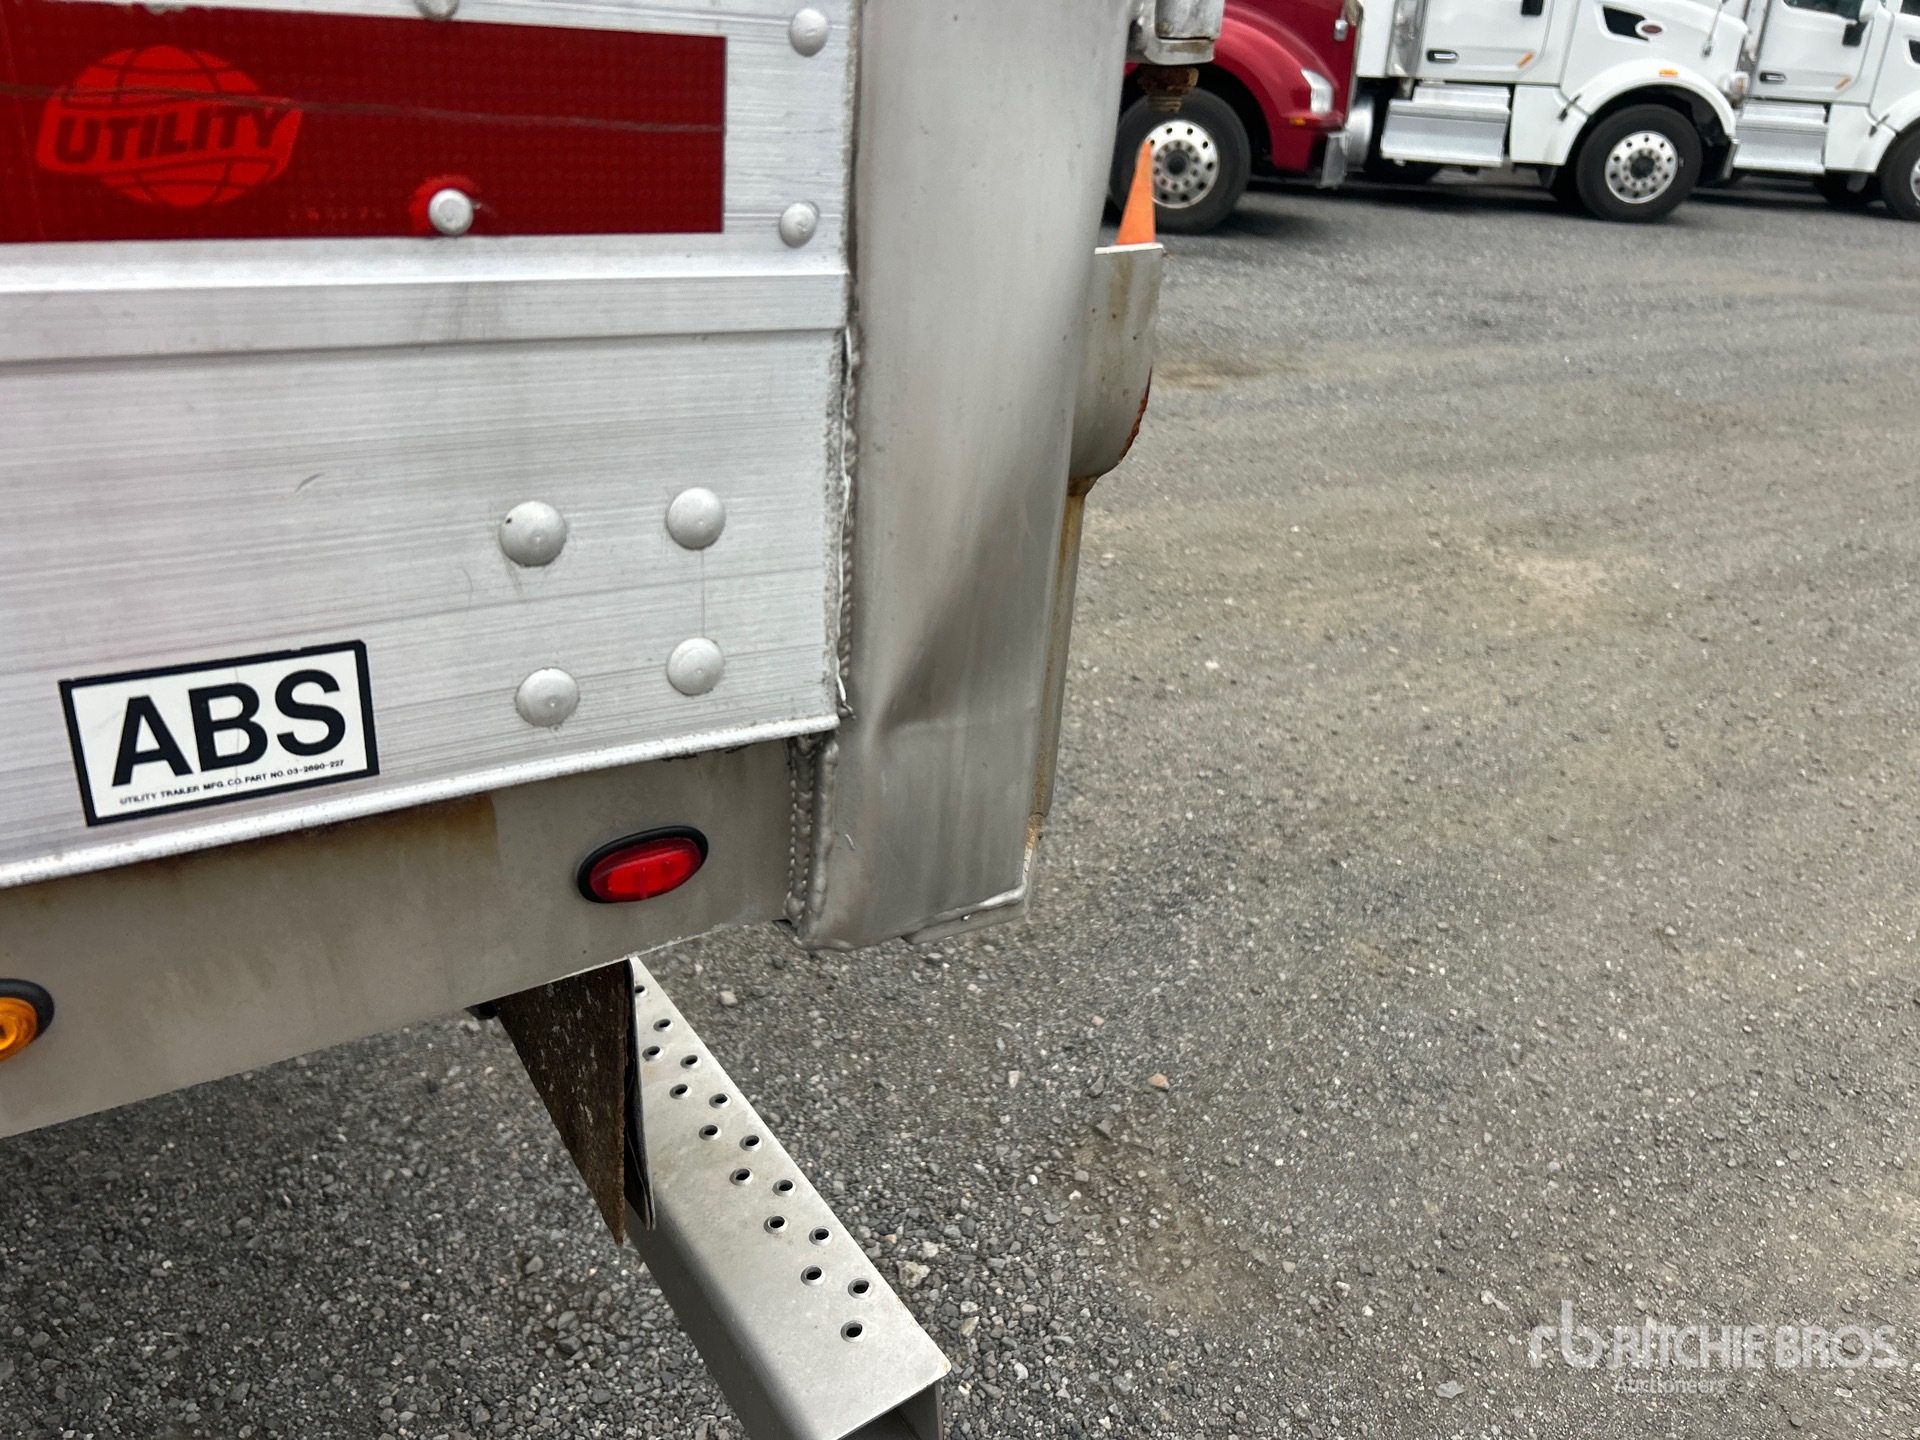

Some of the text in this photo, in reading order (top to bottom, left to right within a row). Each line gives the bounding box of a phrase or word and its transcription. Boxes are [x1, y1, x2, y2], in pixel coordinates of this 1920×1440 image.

[55, 104, 288, 164] UTILITY
[112, 669, 346, 787] ABS
[120, 792, 158, 804] UTILITY
[161, 785, 200, 798] TRAILER
[245, 773, 267, 783] PART
